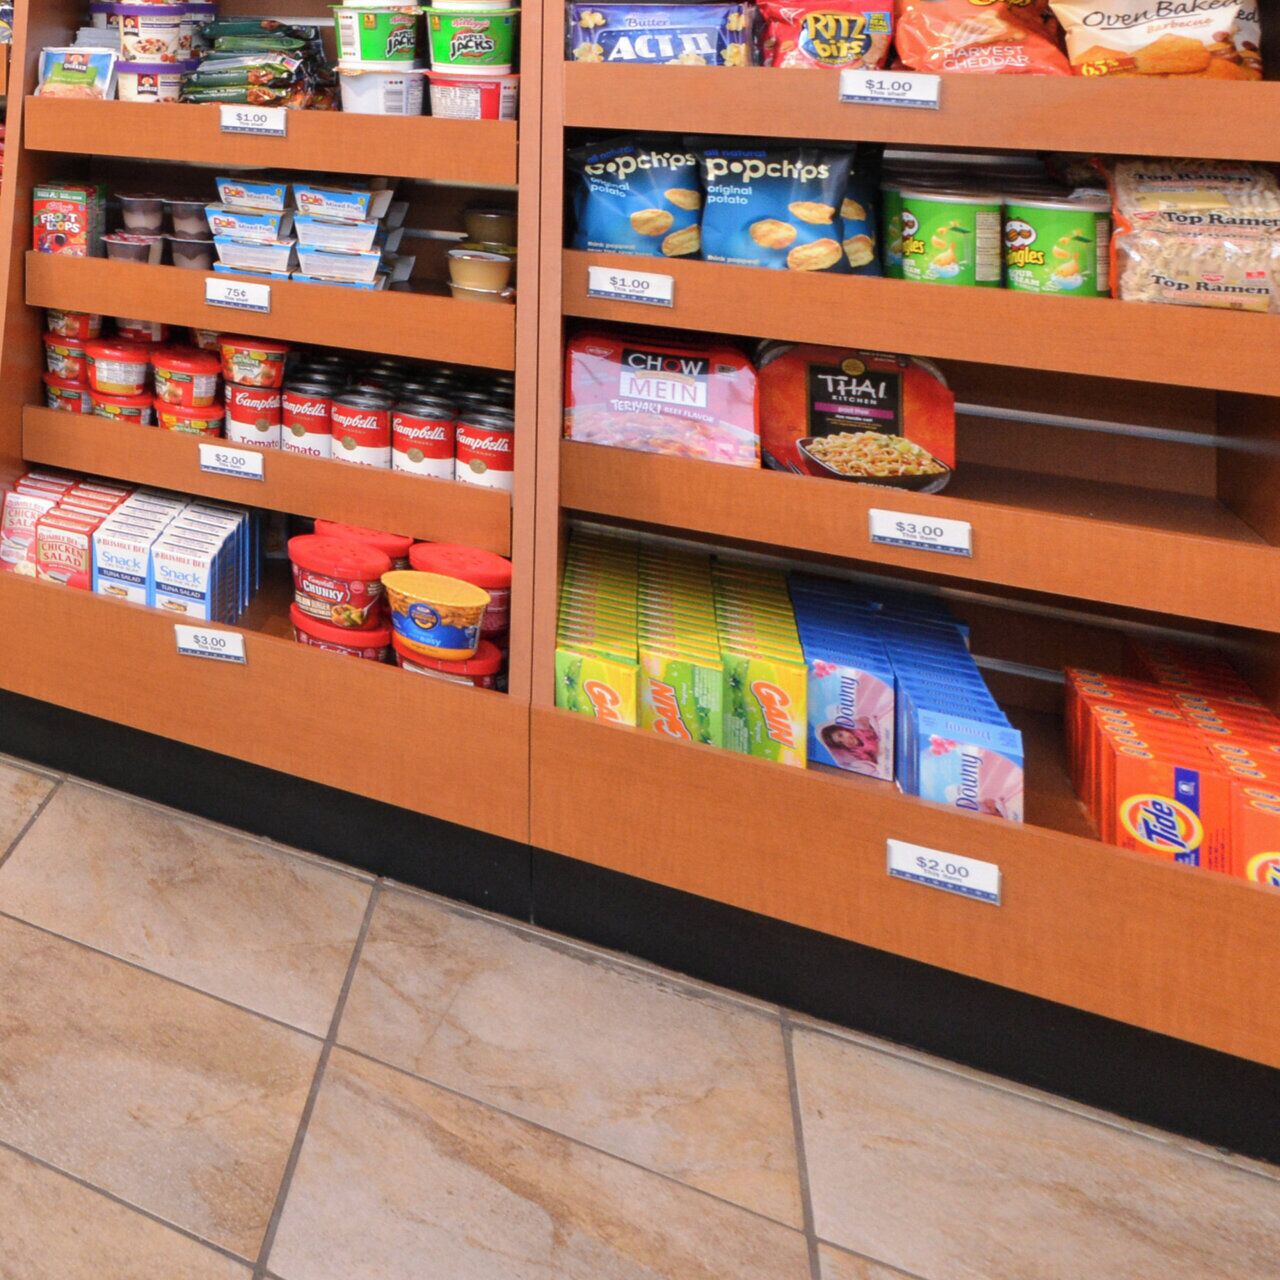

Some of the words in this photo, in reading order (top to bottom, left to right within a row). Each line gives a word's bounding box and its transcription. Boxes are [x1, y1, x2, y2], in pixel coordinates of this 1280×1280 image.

[626, 17, 668, 28] Butter
[806, 13, 867, 40] RITZ
[1082, 9, 1157, 29] Oven
[456, 33, 486, 42] APPLE
[450, 38, 495, 61] JACKS
[608, 34, 675, 61] ACT
[681, 33, 717, 54] II
[812, 35, 865, 58] bits
[943, 46, 1025, 59] HARVEST
[942, 55, 1032, 70] CHEDDAR
[865, 78, 913, 93] $1.00
[236, 111, 268, 124] $1.00
[705, 156, 831, 183] popchips
[223, 186, 246, 199] Dole
[247, 193, 265, 202] Mixed
[590, 184, 628, 199] potato
[707, 184, 753, 196] original
[299, 192, 324, 207] Dole
[325, 200, 345, 210] Mixed
[707, 194, 749, 206] potato
[40, 213, 78, 224] FROOT
[213, 216, 237, 230] Dole
[238, 222, 257, 233] Mixed
[1163, 211, 1201, 227] Top
[46, 221, 81, 234] LOOPS
[609, 275, 651, 291] $1.00
[1152, 274, 1191, 290] Top
[1194, 279, 1271, 296] Ramen
[226, 286, 247, 299] 75¢
[627, 352, 703, 377] CHOW
[628, 381, 698, 404] MEIN
[817, 374, 886, 400] THAI
[610, 399, 662, 416] TERIYAKI
[831, 395, 878, 406] KITCHEN
[240, 436, 280, 449] Tomato
[281, 439, 322, 458] Tomato
[214, 452, 247, 467] $2.00
[895, 520, 944, 538] $3.00
[41, 542, 84, 559] CHICKEN
[43, 550, 82, 568] SALAD
[101, 550, 142, 569] Snack
[102, 568, 120, 579] TUNA
[120, 572, 142, 584] SALAD
[160, 564, 201, 584] Snack
[160, 583, 179, 594] TUNA
[179, 586, 202, 599] SALAD
[302, 580, 345, 602] CHUNKY
[193, 634, 227, 648] $3.00
[419, 635, 442, 647] easy
[834, 675, 860, 732] Downy
[750, 679, 797, 750] GAIN
[956, 752, 984, 812] Downy
[1142, 799, 1188, 850] Tide
[916, 855, 970, 879] $2.00
